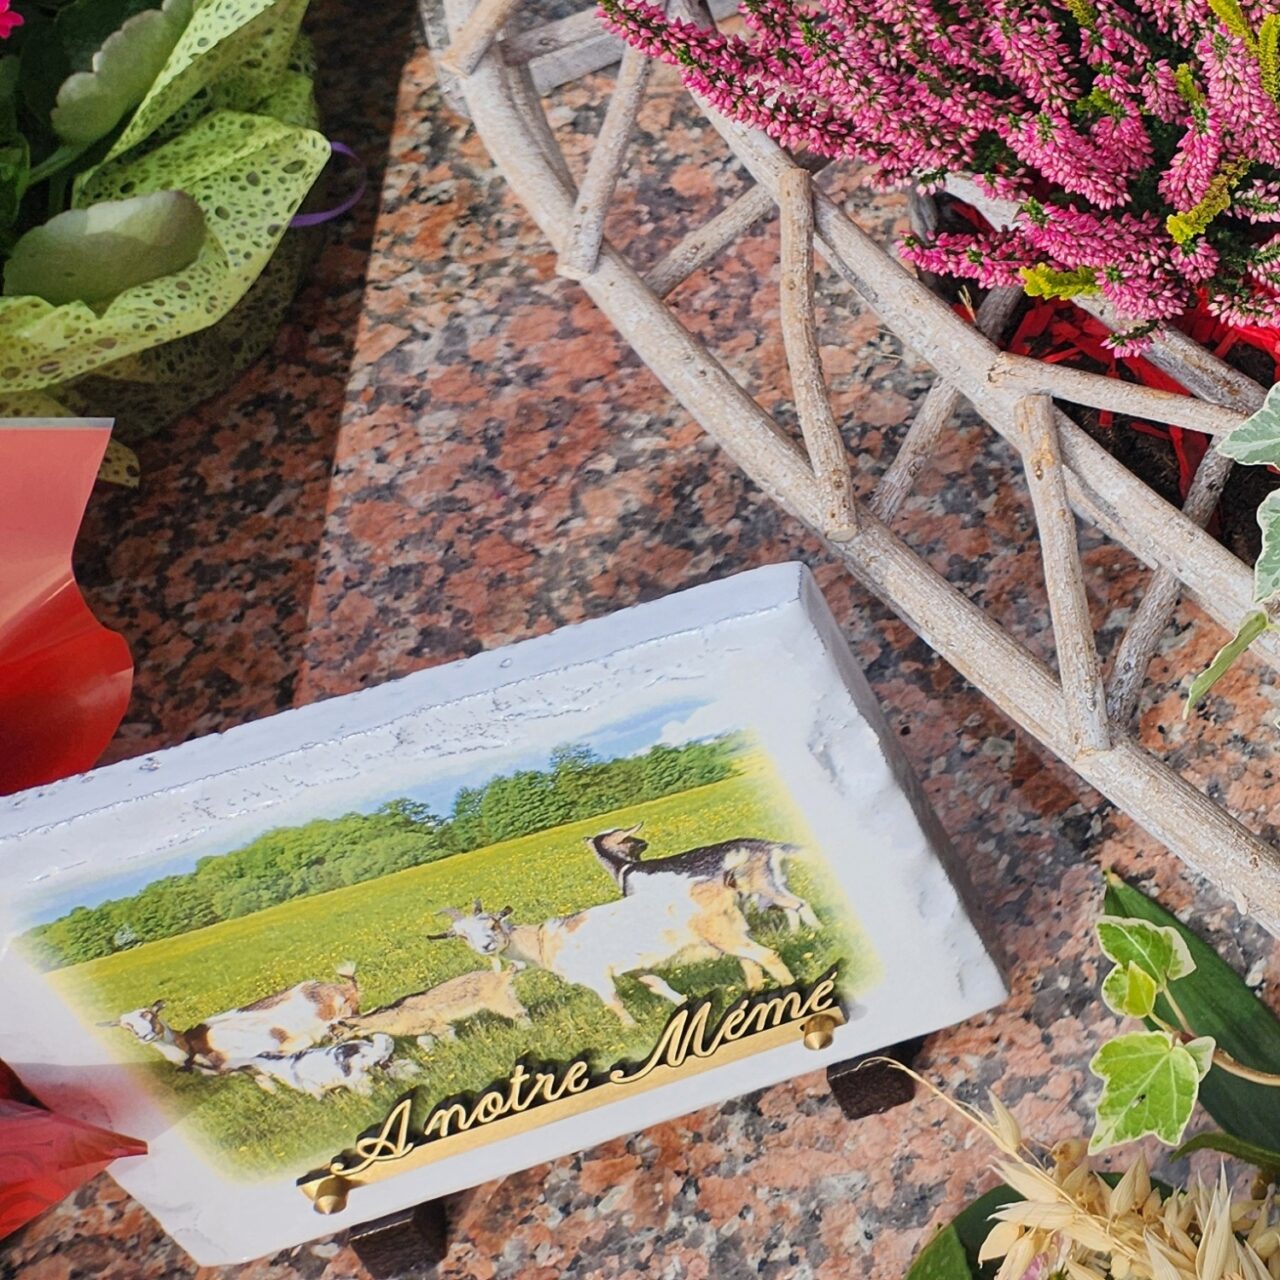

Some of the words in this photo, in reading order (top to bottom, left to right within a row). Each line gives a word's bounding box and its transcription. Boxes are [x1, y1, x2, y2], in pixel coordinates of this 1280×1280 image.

[330, 1098, 415, 1176] A
[424, 1060, 590, 1138] notre
[609, 971, 838, 1085] Mémé
